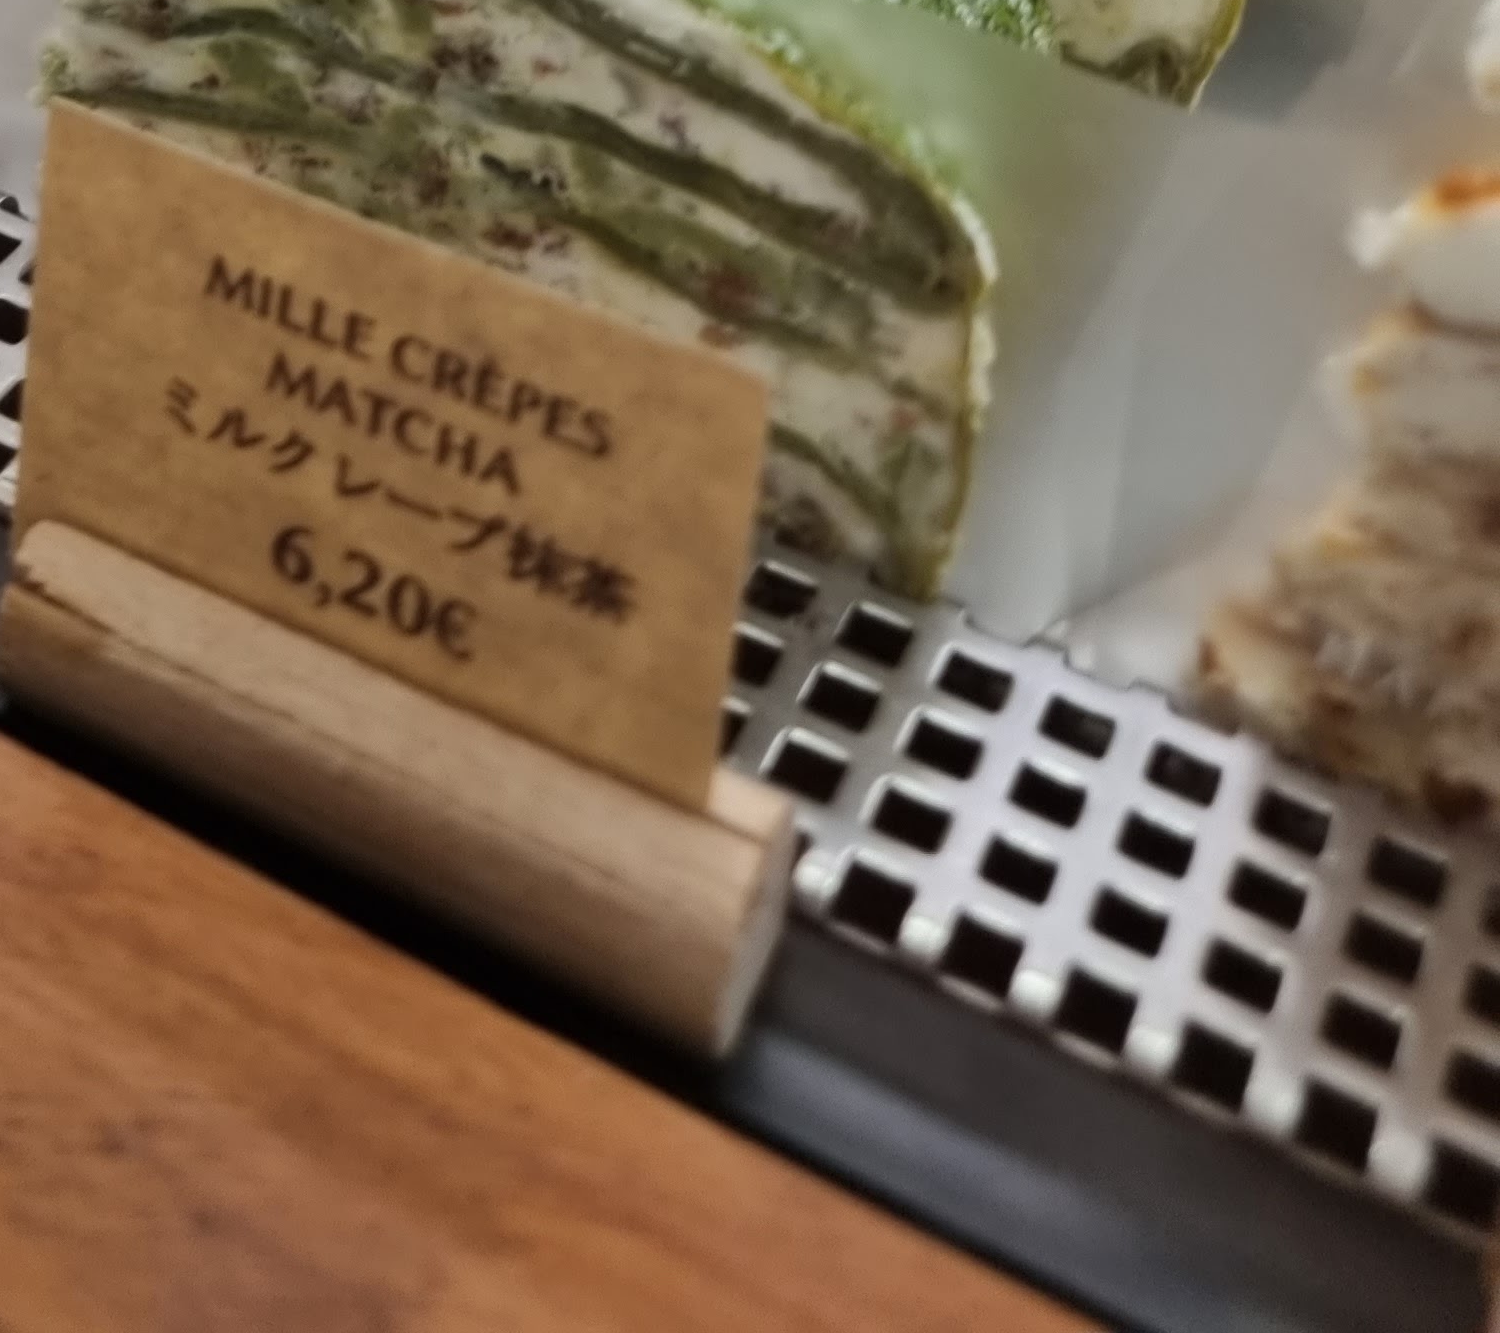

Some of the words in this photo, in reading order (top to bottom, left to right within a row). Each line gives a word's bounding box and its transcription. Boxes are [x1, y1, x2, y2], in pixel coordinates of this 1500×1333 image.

[204, 253, 379, 362] MILLE
[265, 353, 521, 496] MATCHA
[270, 525, 480, 663] 6,20€
